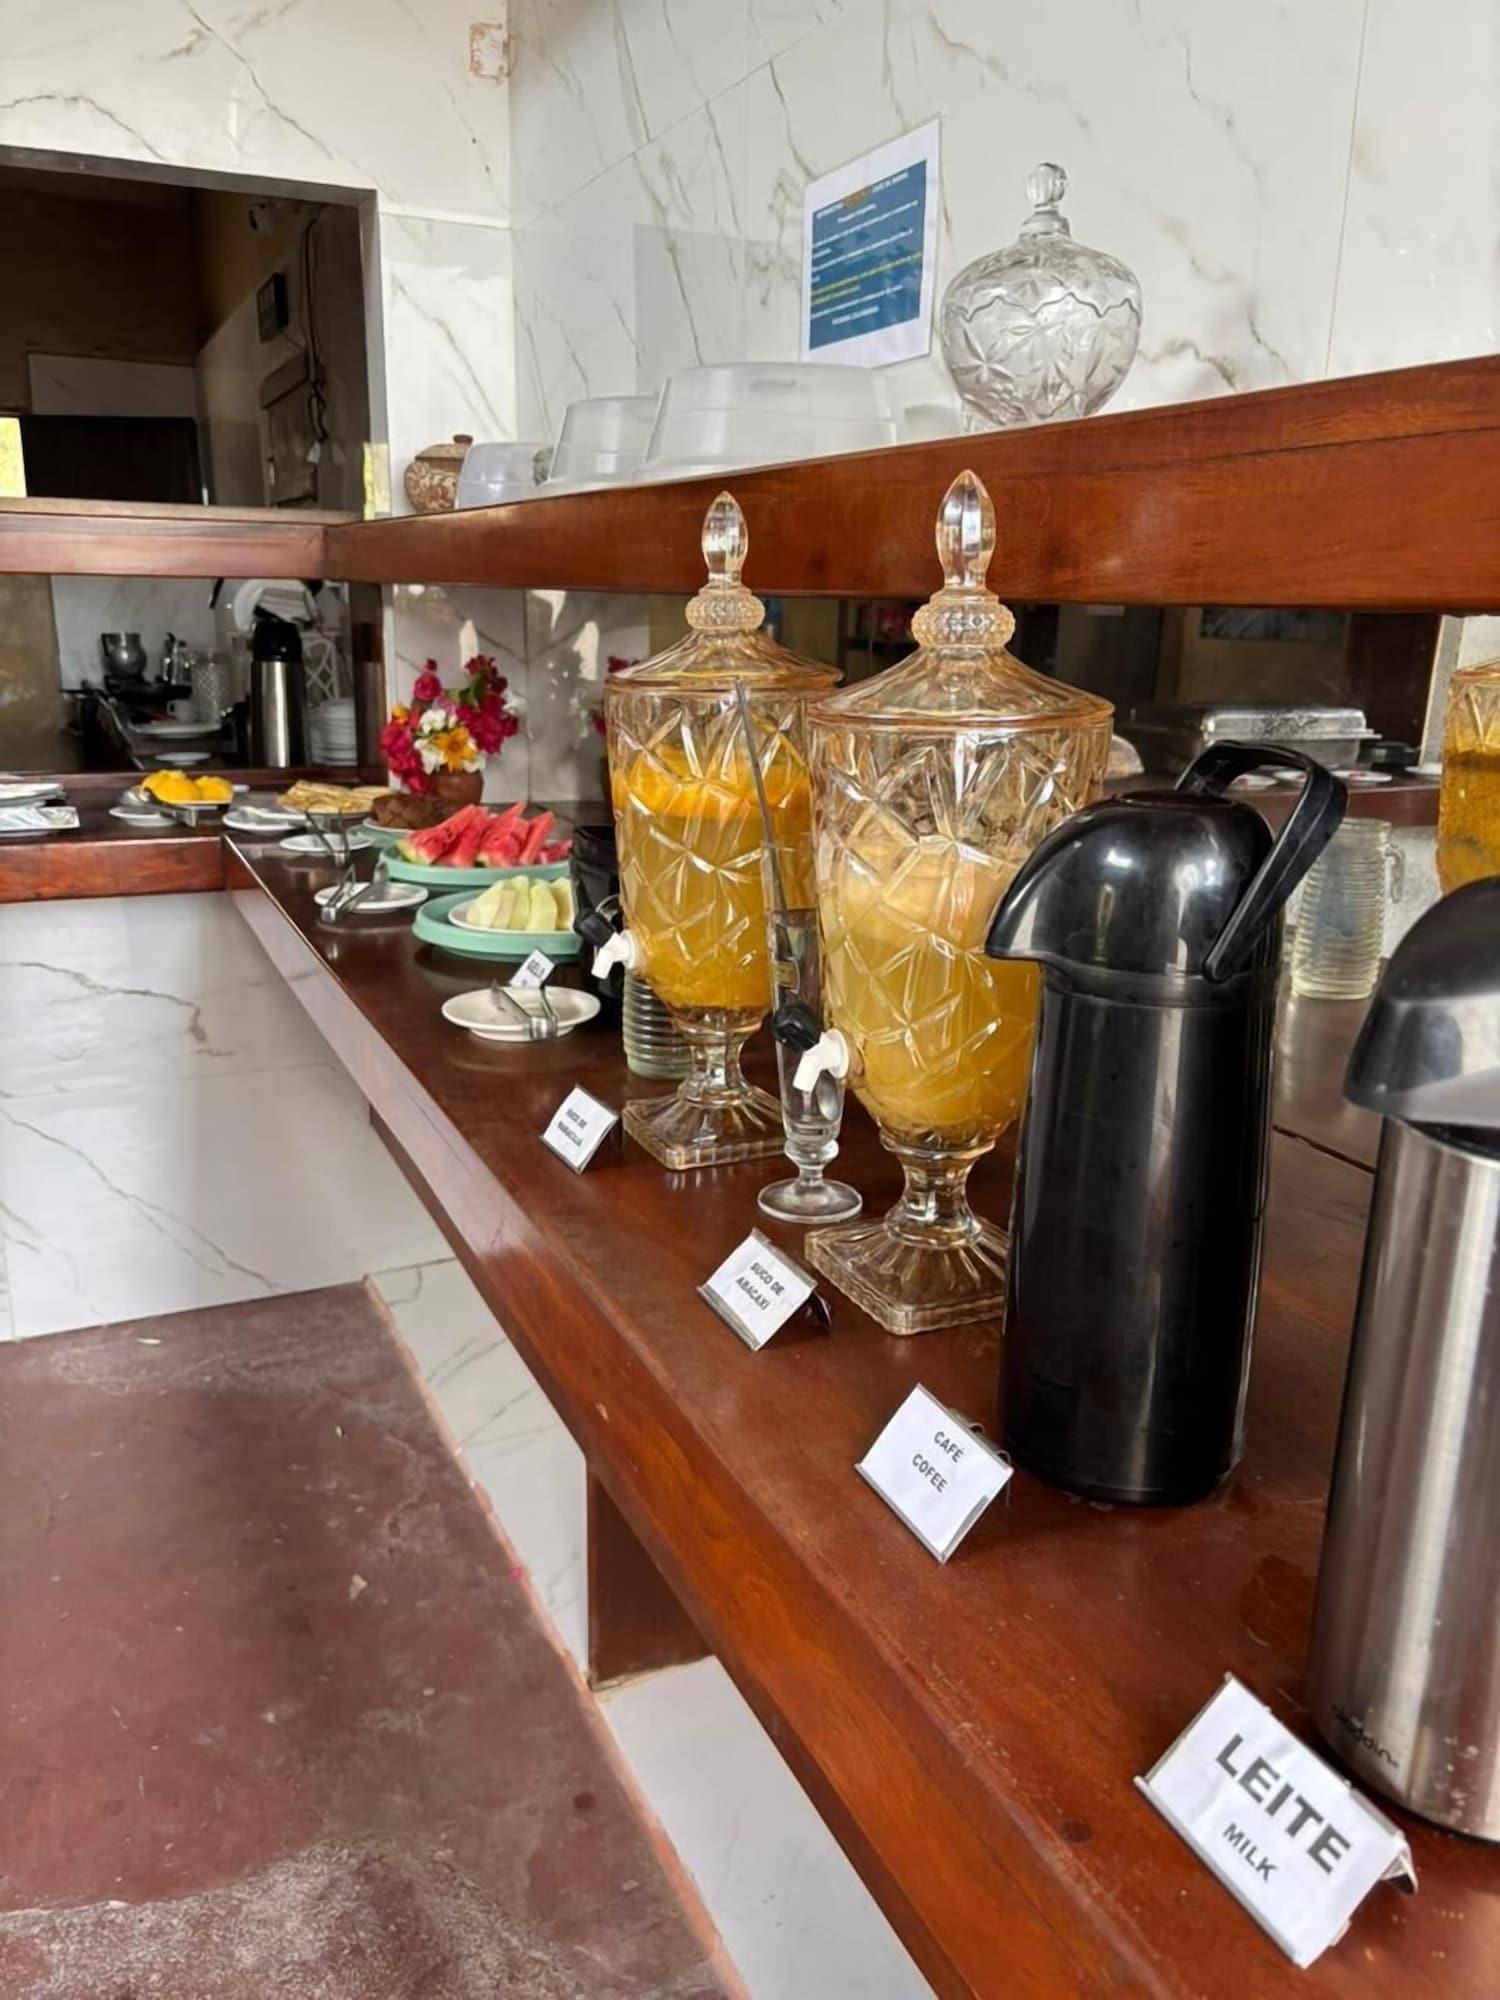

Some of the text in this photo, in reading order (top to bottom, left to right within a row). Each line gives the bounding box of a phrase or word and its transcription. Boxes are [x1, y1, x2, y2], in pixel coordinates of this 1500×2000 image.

[736, 1276, 770, 1311] ABACAXI
[750, 1262, 785, 1297] SUCO DE
[911, 1453, 949, 1494] COFEE
[1215, 1733, 1354, 1876] LEITE
[1223, 1822, 1279, 1884] MILK
